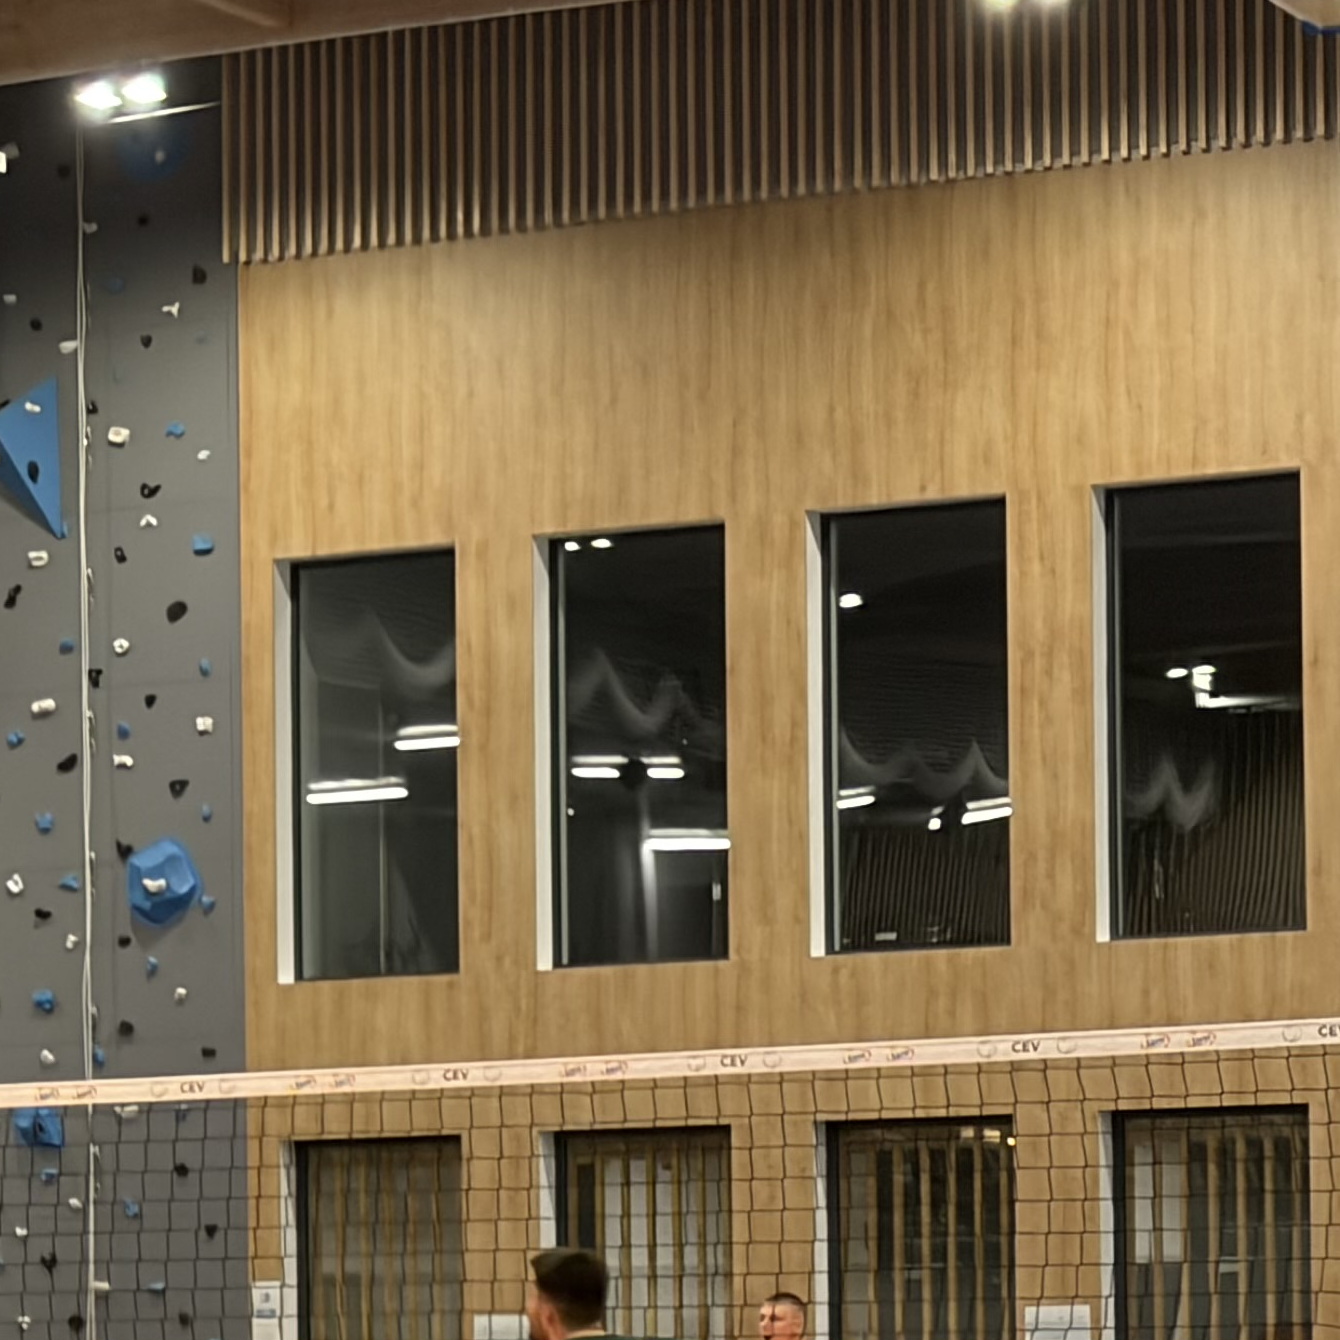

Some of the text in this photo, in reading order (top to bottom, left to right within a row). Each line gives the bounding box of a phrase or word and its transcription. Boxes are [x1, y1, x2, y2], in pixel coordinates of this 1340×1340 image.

[1318, 1023, 1340, 1038] CE
[1012, 1039, 1041, 1053] CEV
[720, 1053, 748, 1067] CEV
[443, 1067, 470, 1082] CEV
[179, 1080, 206, 1094] CEV
